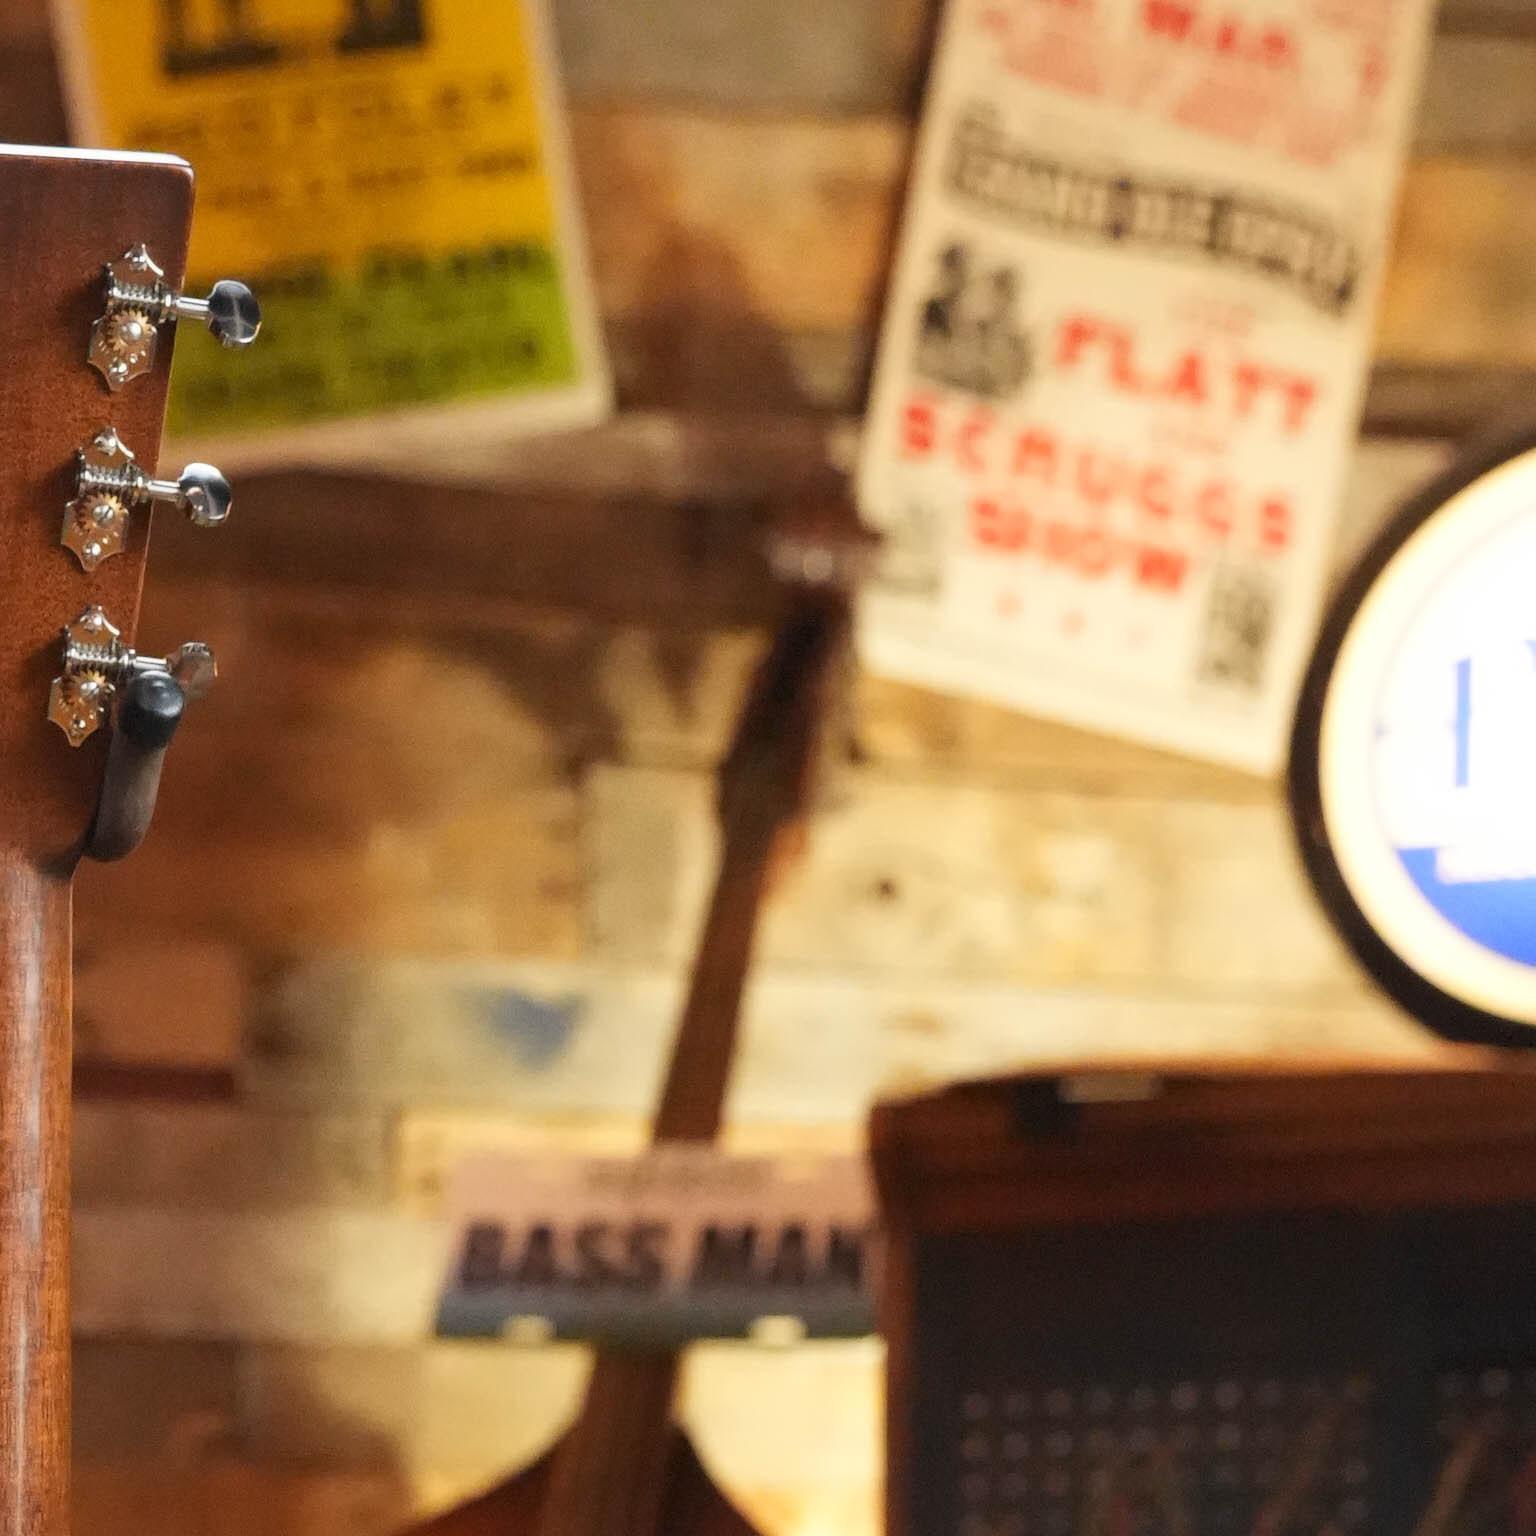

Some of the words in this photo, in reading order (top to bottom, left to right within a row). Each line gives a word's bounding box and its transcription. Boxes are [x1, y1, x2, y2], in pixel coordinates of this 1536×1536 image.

[1054, 315, 1320, 432] FLATT
[899, 395, 1294, 555] SCRUGGS
[972, 497, 1192, 597] SHOW
